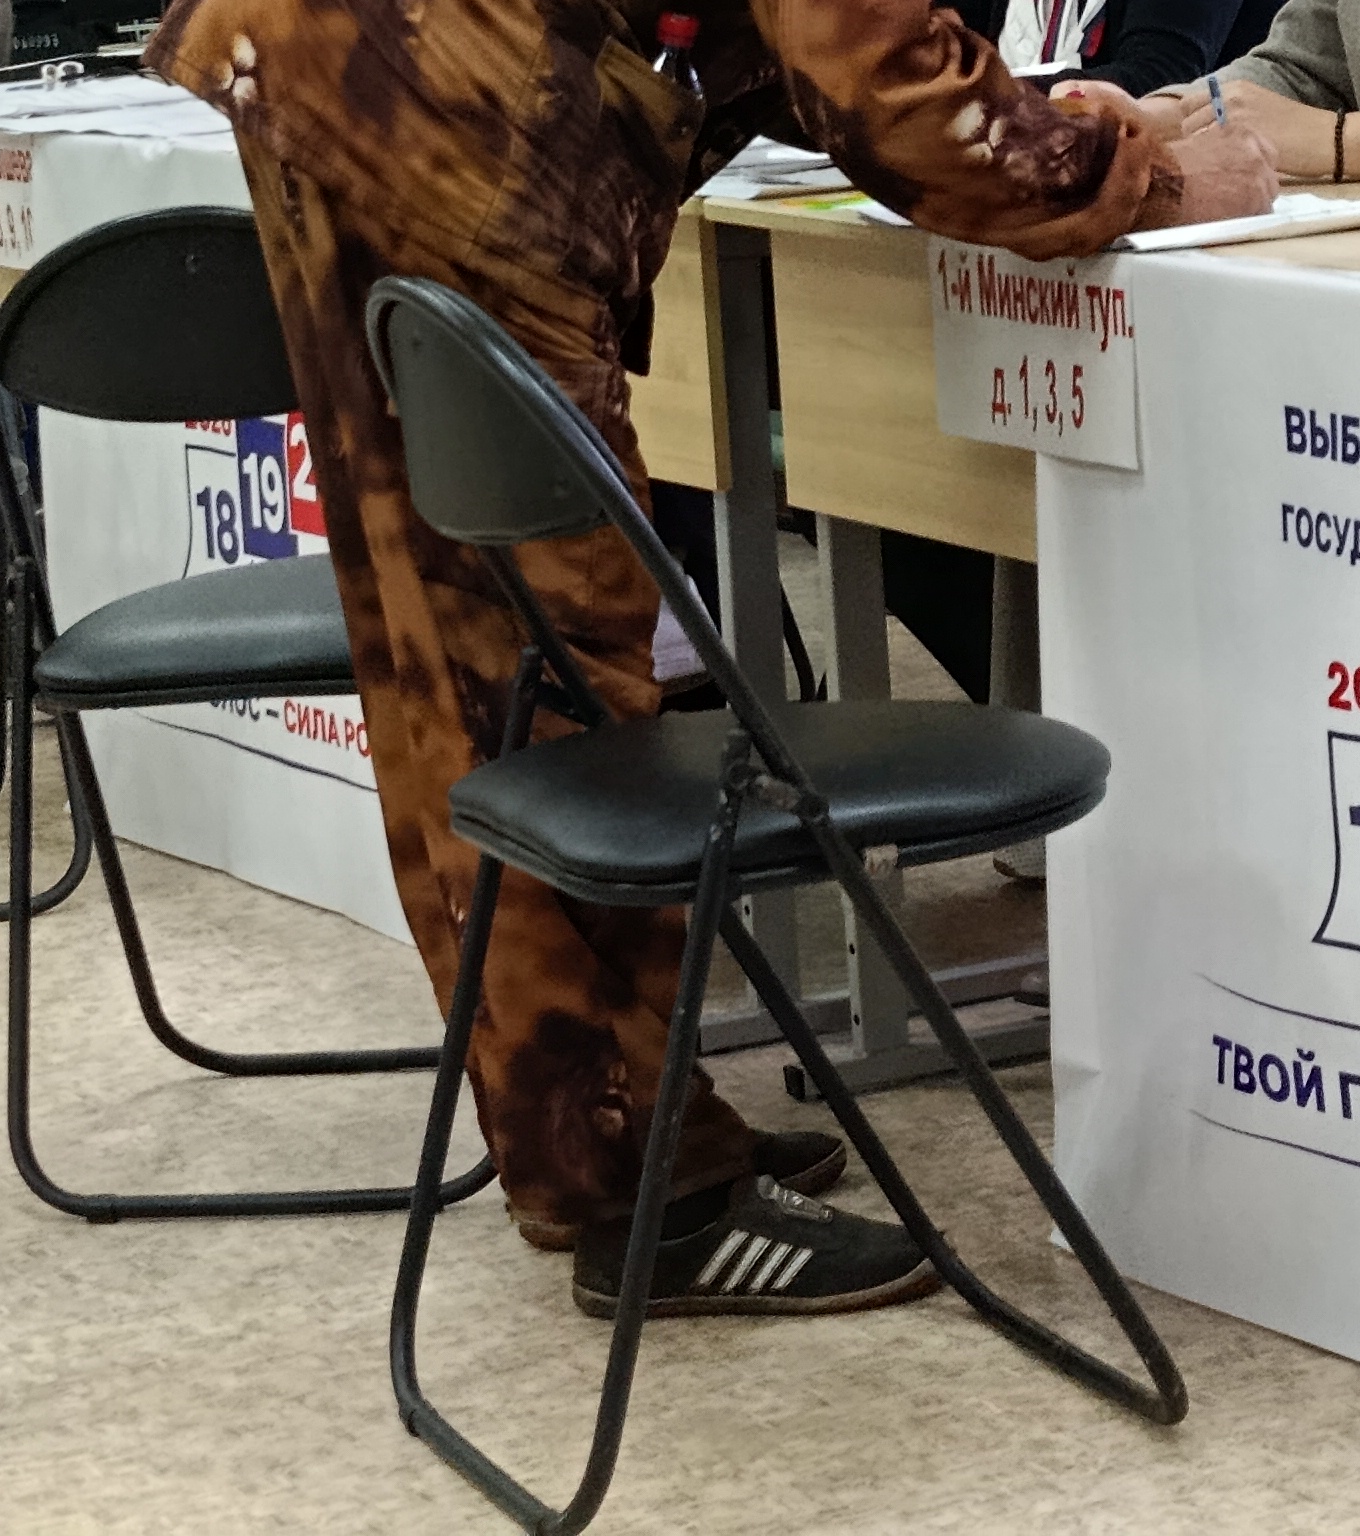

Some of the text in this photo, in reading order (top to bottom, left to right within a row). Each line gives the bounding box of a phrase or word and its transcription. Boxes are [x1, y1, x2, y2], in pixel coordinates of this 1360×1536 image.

[938, 249, 1135, 353] 1-й Минский туп.
[992, 355, 1085, 438] д. 1, 3, 5
[196, 422, 317, 564] 18 19 2
[283, 698, 342, 748] СИЛА
[1211, 1033, 1327, 1114] ТВОЙ
